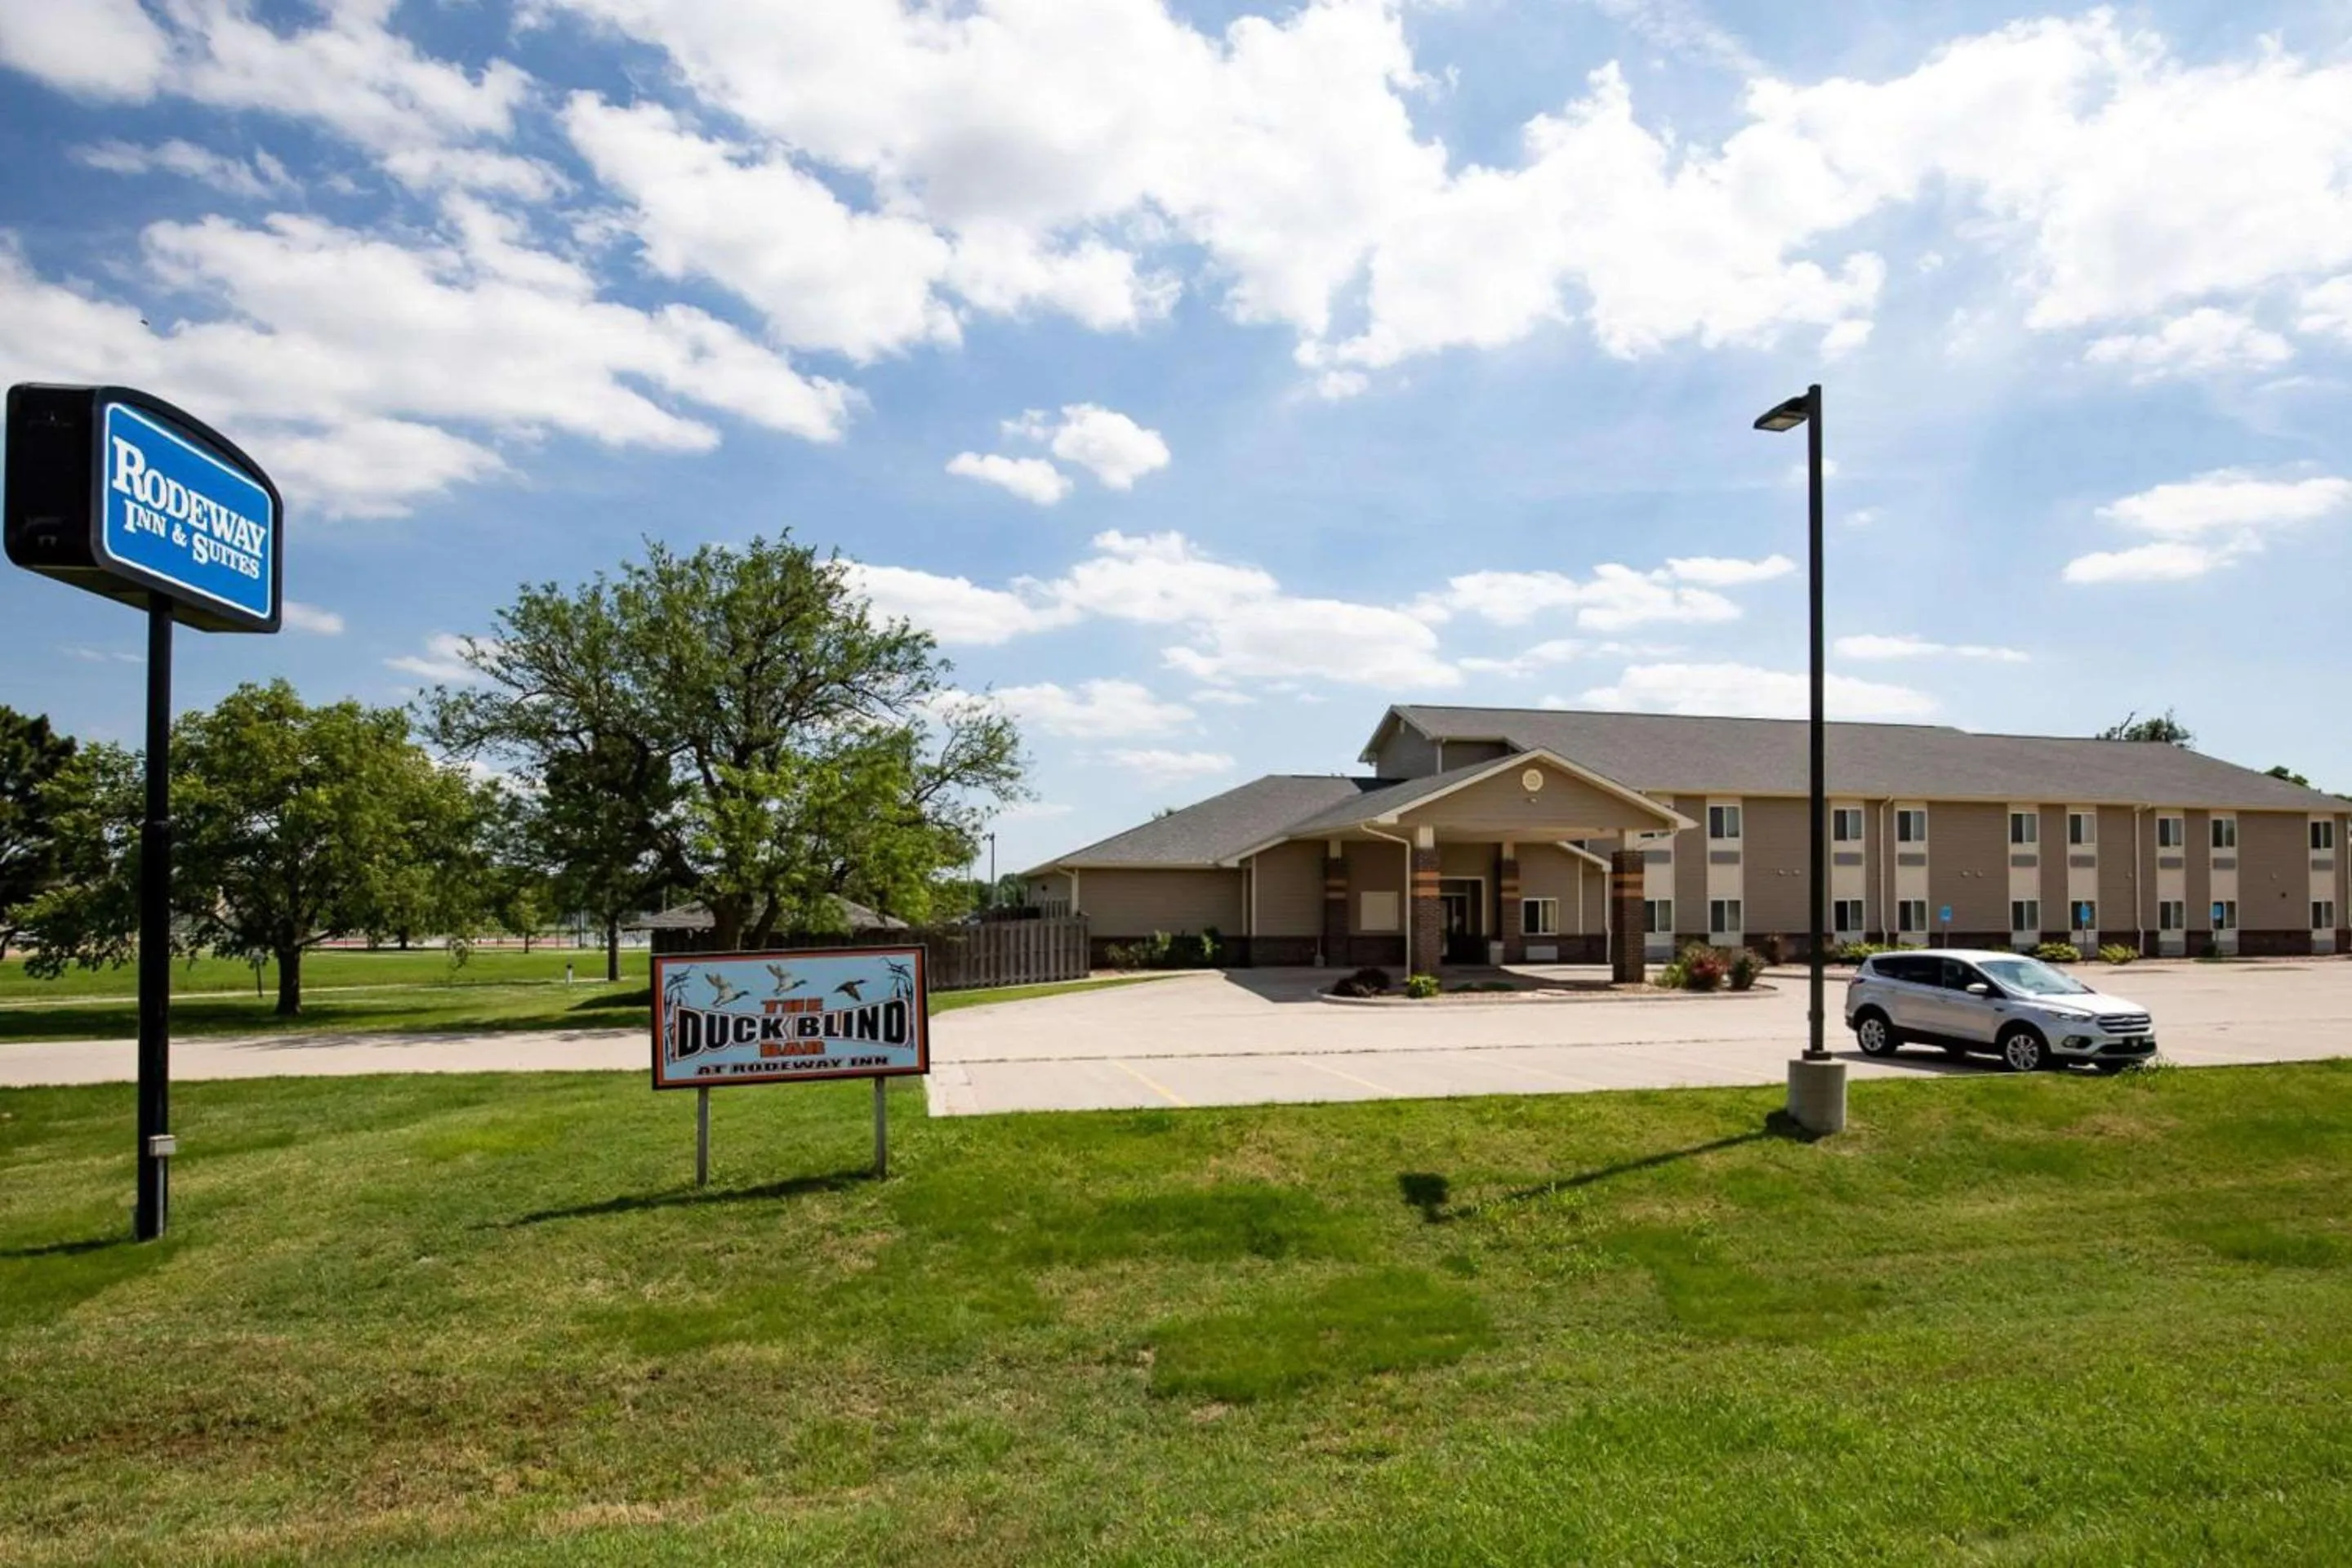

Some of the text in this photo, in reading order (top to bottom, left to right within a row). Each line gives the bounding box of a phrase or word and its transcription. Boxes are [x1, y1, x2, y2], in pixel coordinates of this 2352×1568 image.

[112, 436, 266, 557] RODEWAY
[124, 499, 261, 580] INN & SUITES
[760, 997, 824, 1013] THE
[676, 1000, 909, 1059] DUCK BLIND
[759, 1040, 826, 1058] BAR
[696, 1056, 889, 1076] AT RODEWAY INN
